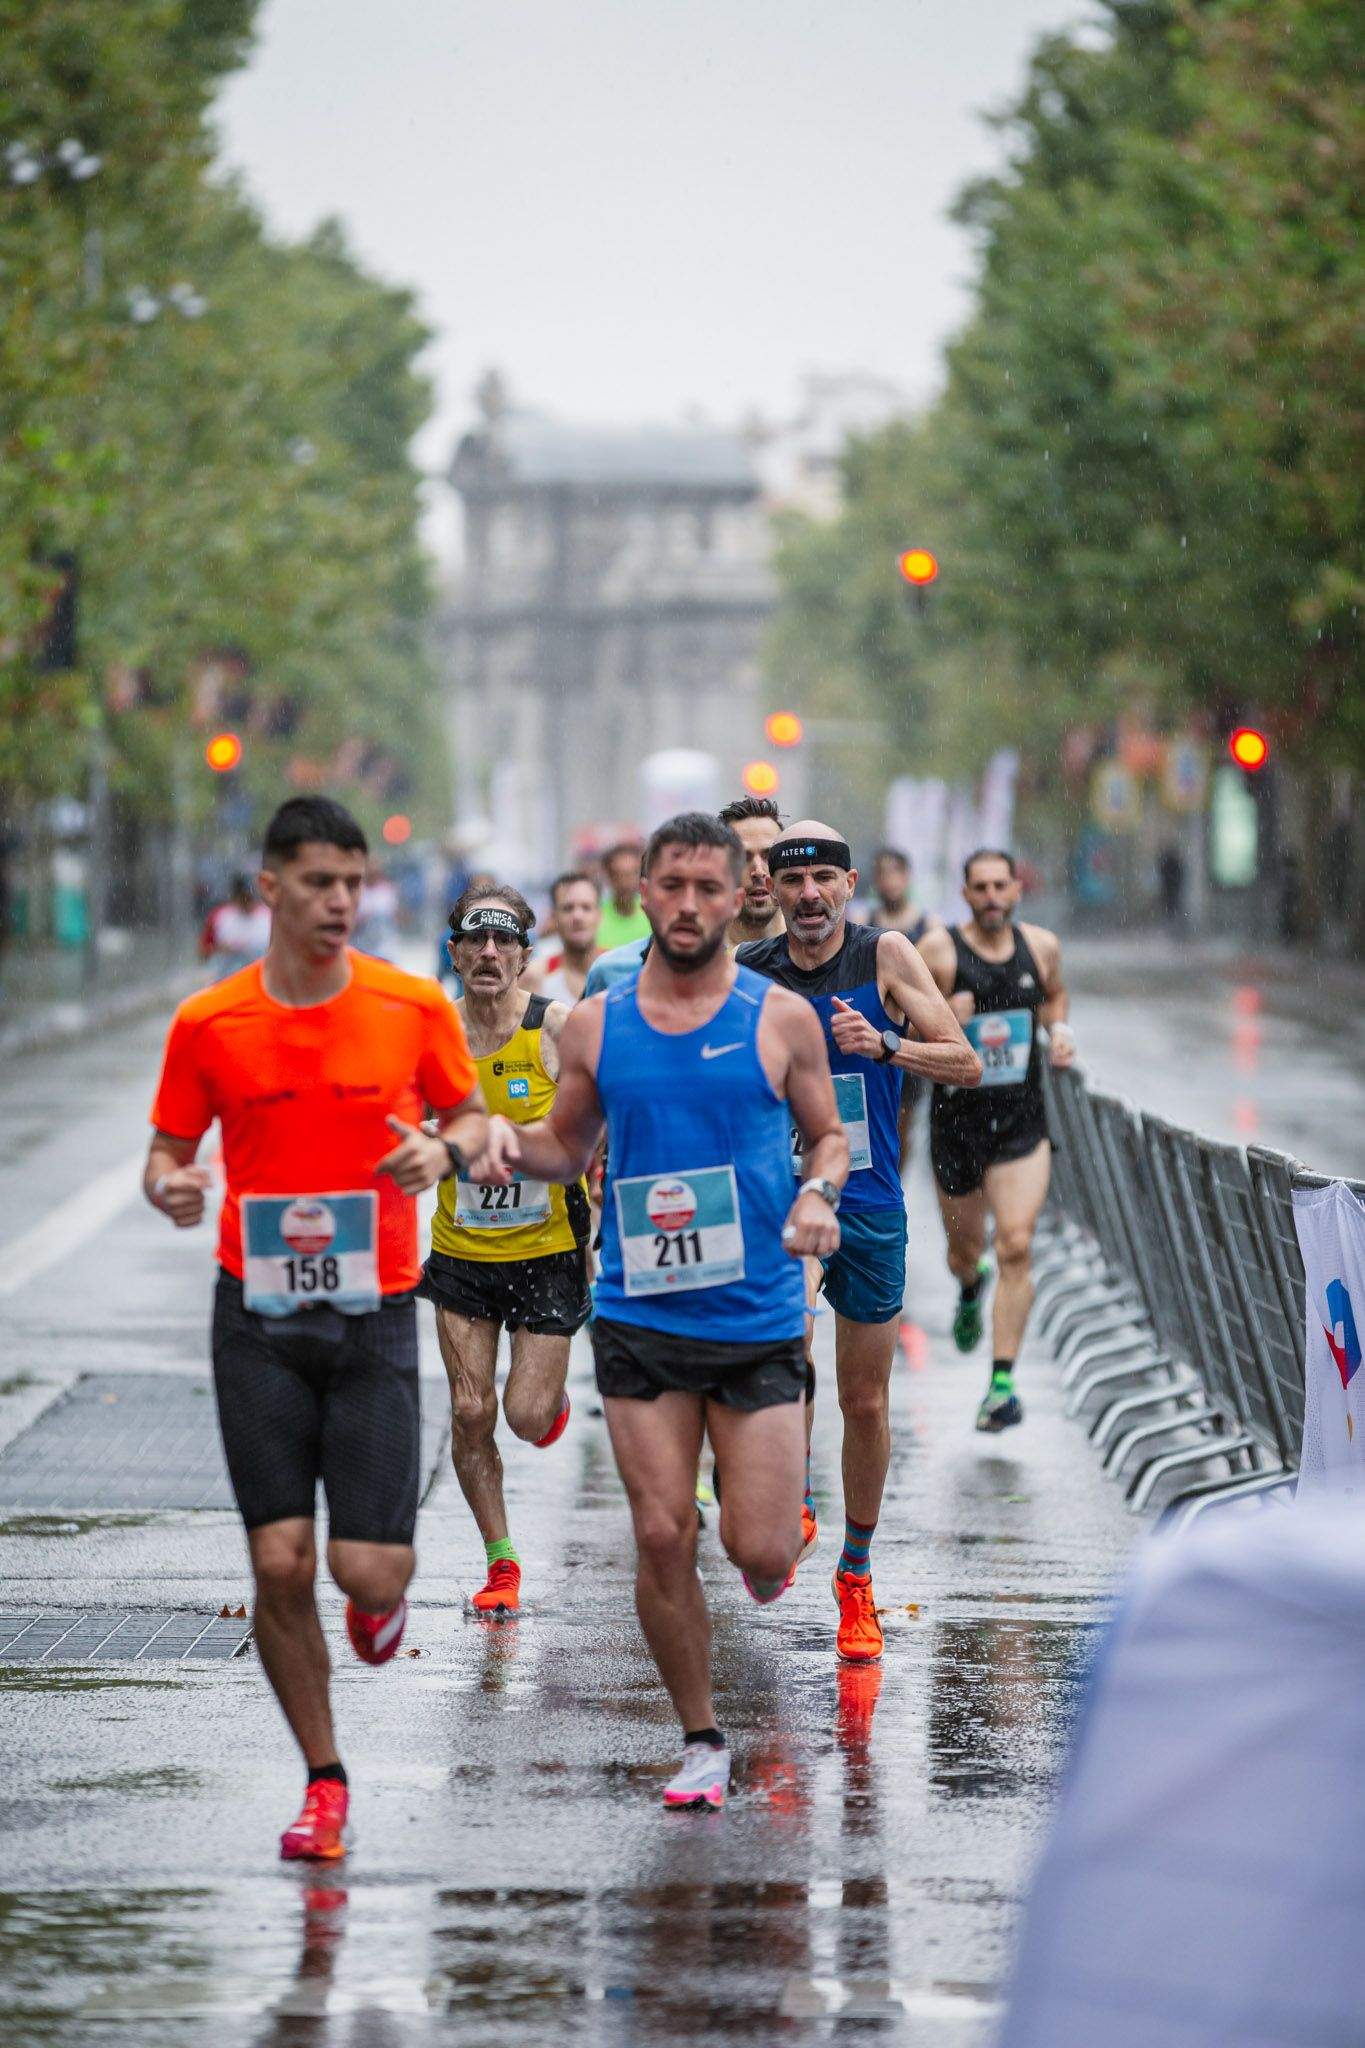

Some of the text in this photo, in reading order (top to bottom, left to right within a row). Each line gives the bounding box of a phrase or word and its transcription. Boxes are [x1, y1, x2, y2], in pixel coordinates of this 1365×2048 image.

[480, 916, 520, 934] MENORCA
[511, 1083, 527, 1094] ISC
[479, 1182, 522, 1210] 227
[654, 1229, 703, 1268] 211
[284, 1256, 339, 1291] 158
